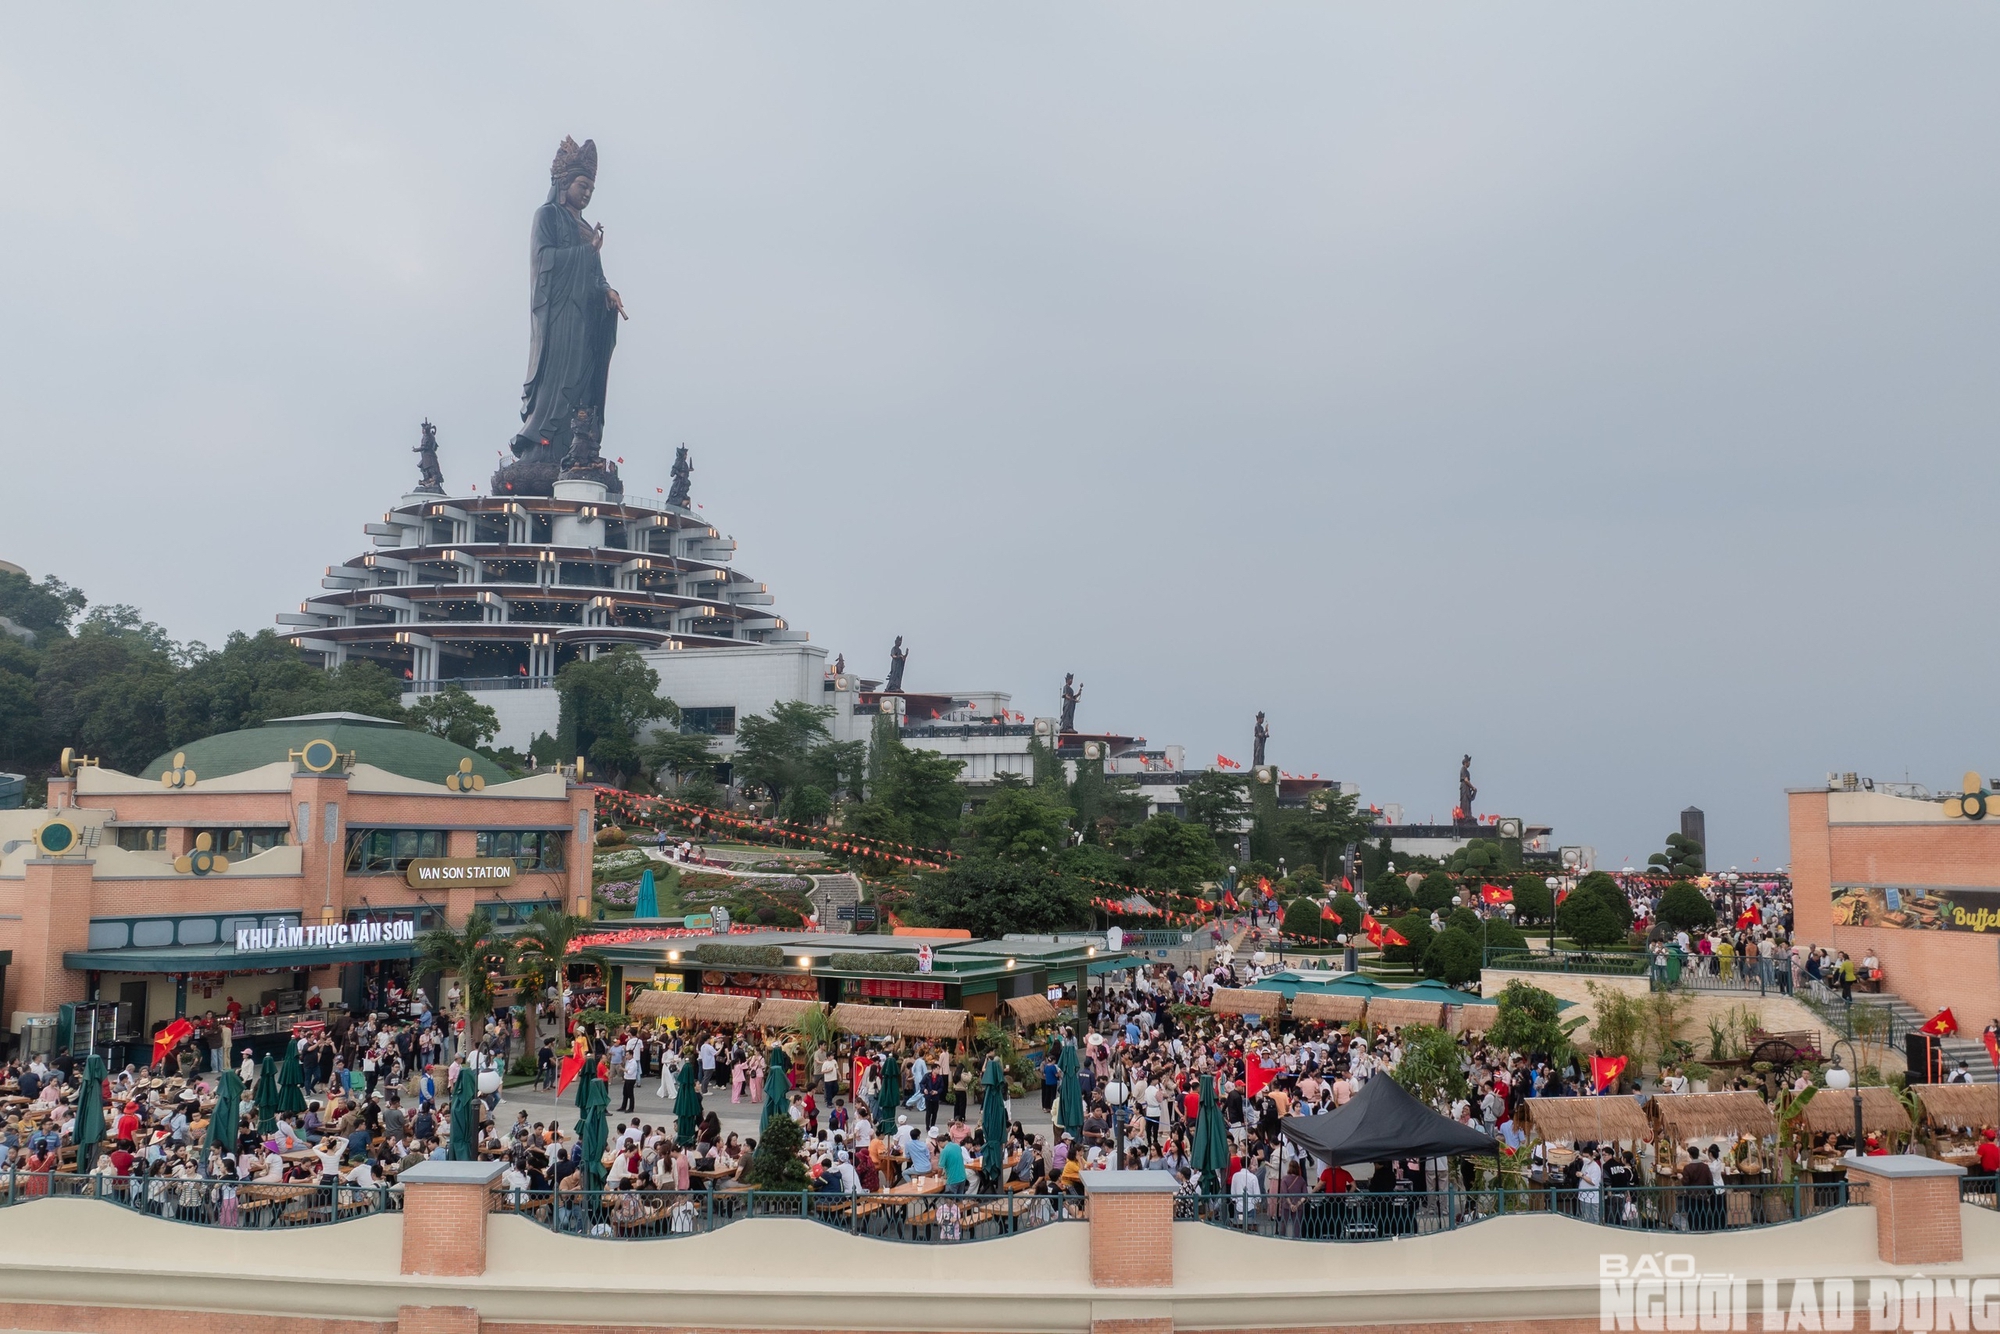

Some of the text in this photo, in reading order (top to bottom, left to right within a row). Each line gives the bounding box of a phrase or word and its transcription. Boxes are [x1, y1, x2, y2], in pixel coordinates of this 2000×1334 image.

[419, 866, 511, 879] VAN SON STATION
[236, 917, 414, 950] KHU ẨM THỰC VÂN SƠN
